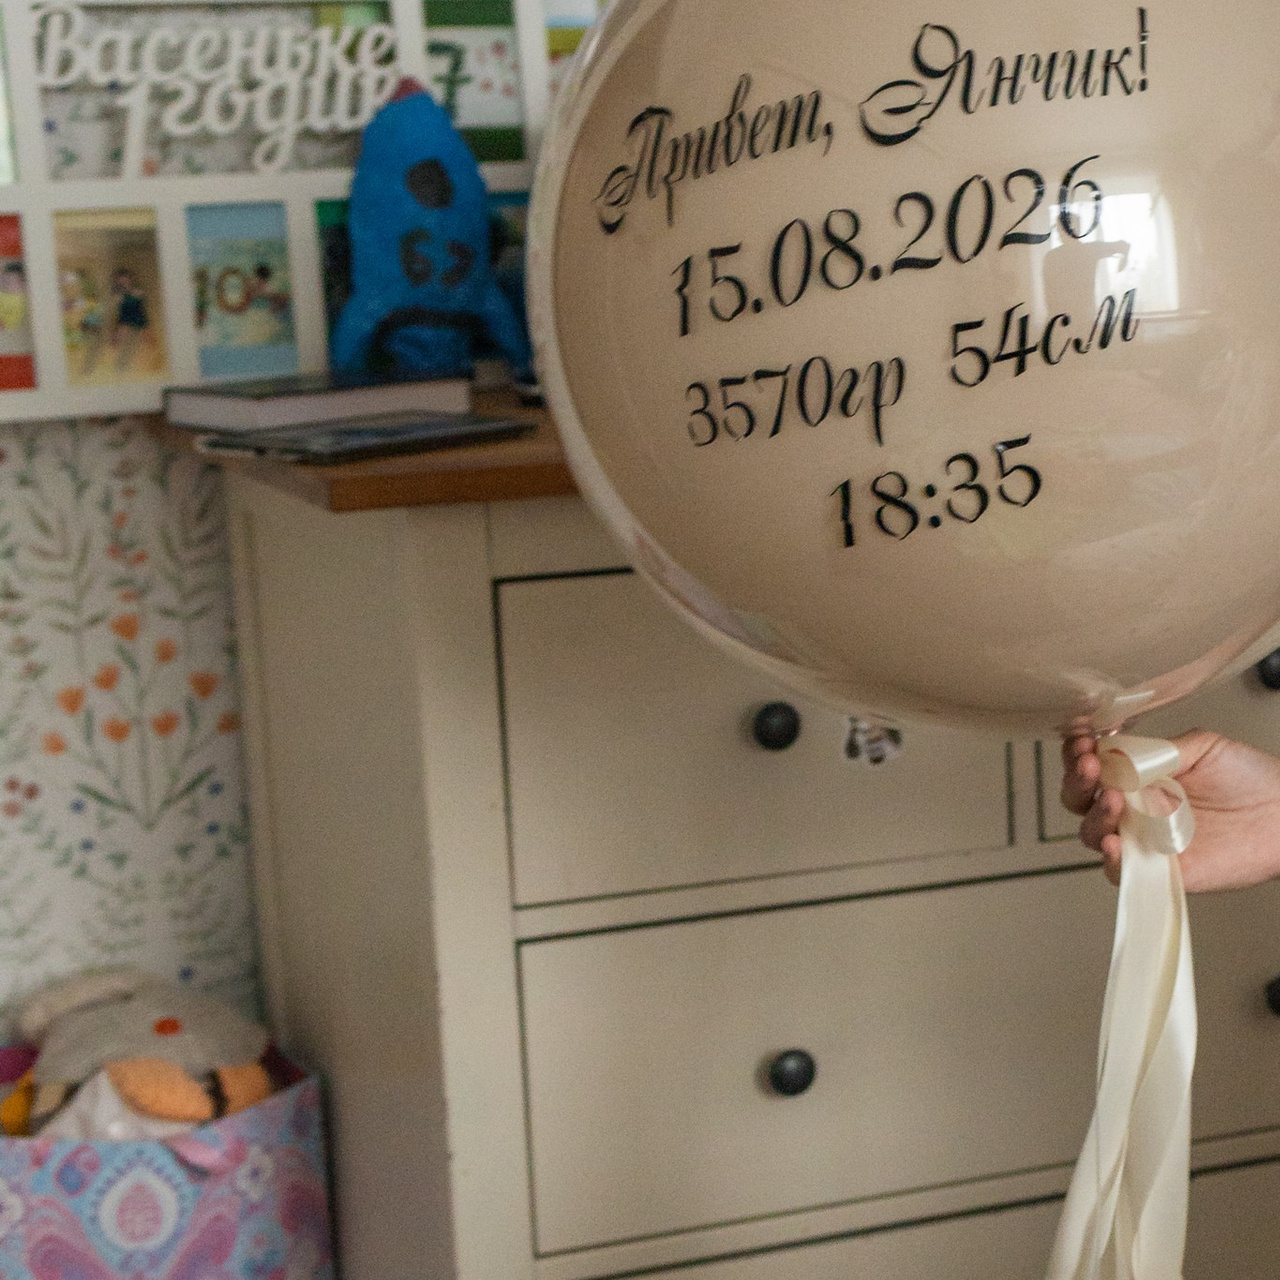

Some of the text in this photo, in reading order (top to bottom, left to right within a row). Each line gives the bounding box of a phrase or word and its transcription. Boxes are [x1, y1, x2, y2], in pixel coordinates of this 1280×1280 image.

[32, 4, 399, 87] Васеньке
[593, 6, 1150, 236] Привет, Янчик!
[671, 154, 1104, 338] 15.08.2026
[684, 287, 1141, 448] 3570гр 54см
[829, 432, 1044, 549] 18:35
